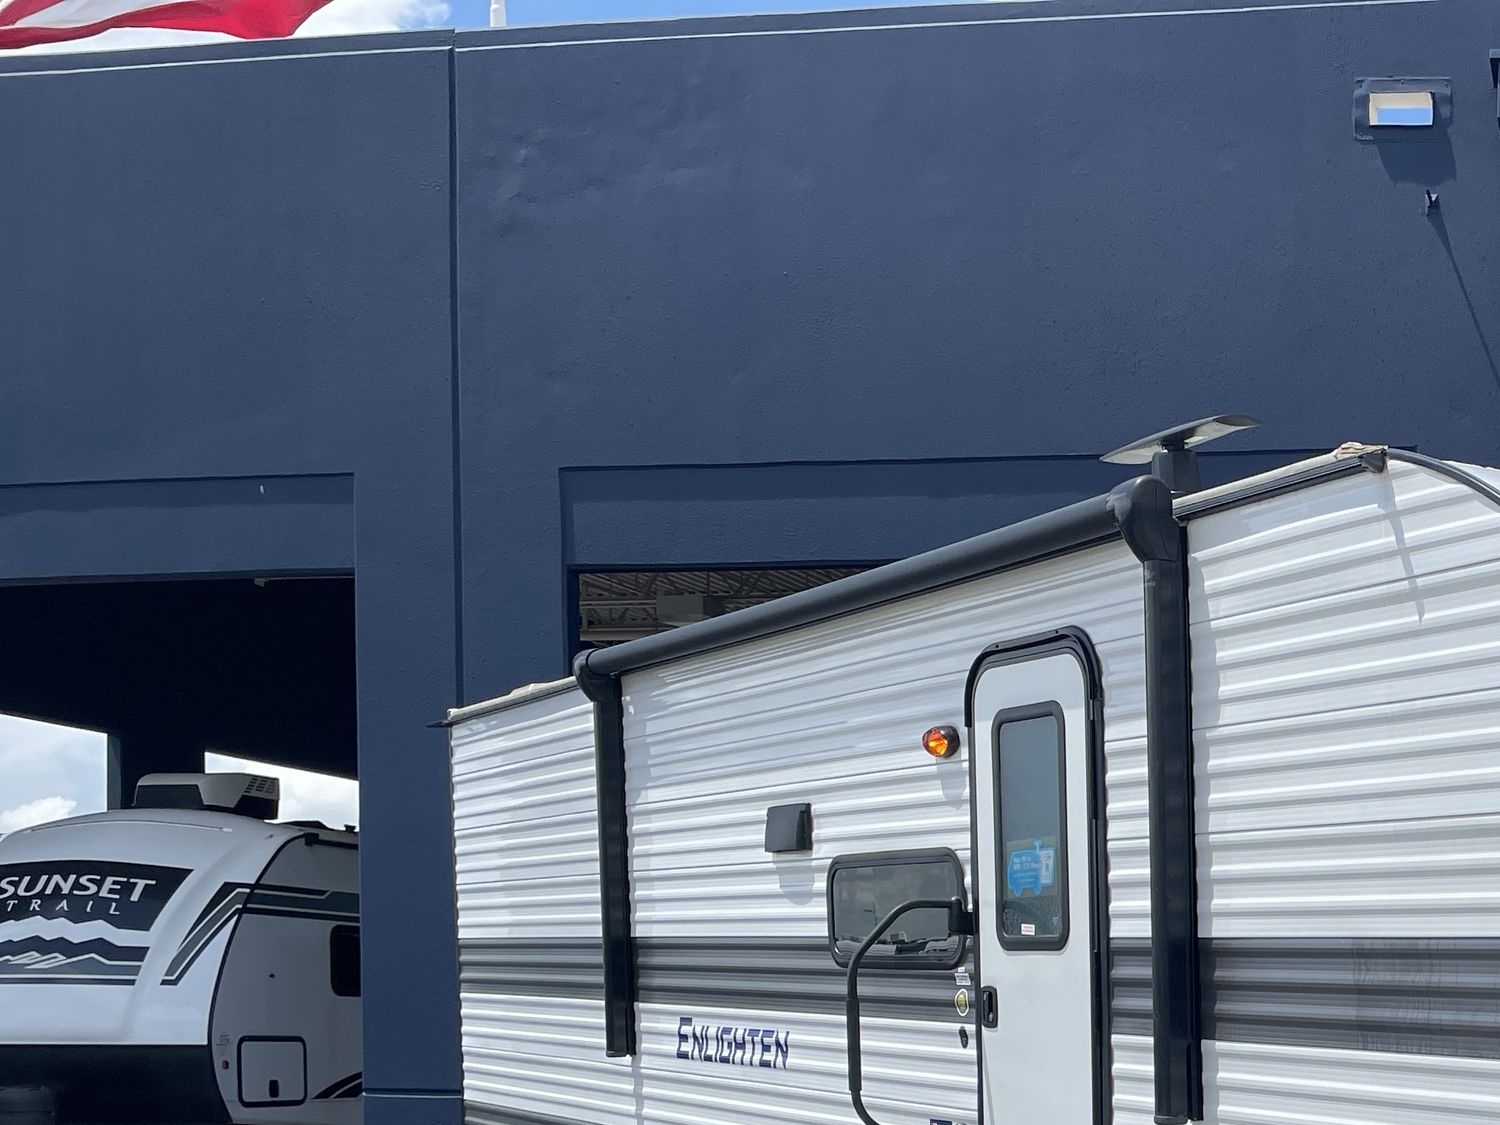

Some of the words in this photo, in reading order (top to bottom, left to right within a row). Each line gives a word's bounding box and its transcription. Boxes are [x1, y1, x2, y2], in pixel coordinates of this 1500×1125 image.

[0, 874, 156, 902] SUNSET
[6, 899, 121, 915] TRAIL
[676, 1017, 790, 1071] ENLIGHTEN
